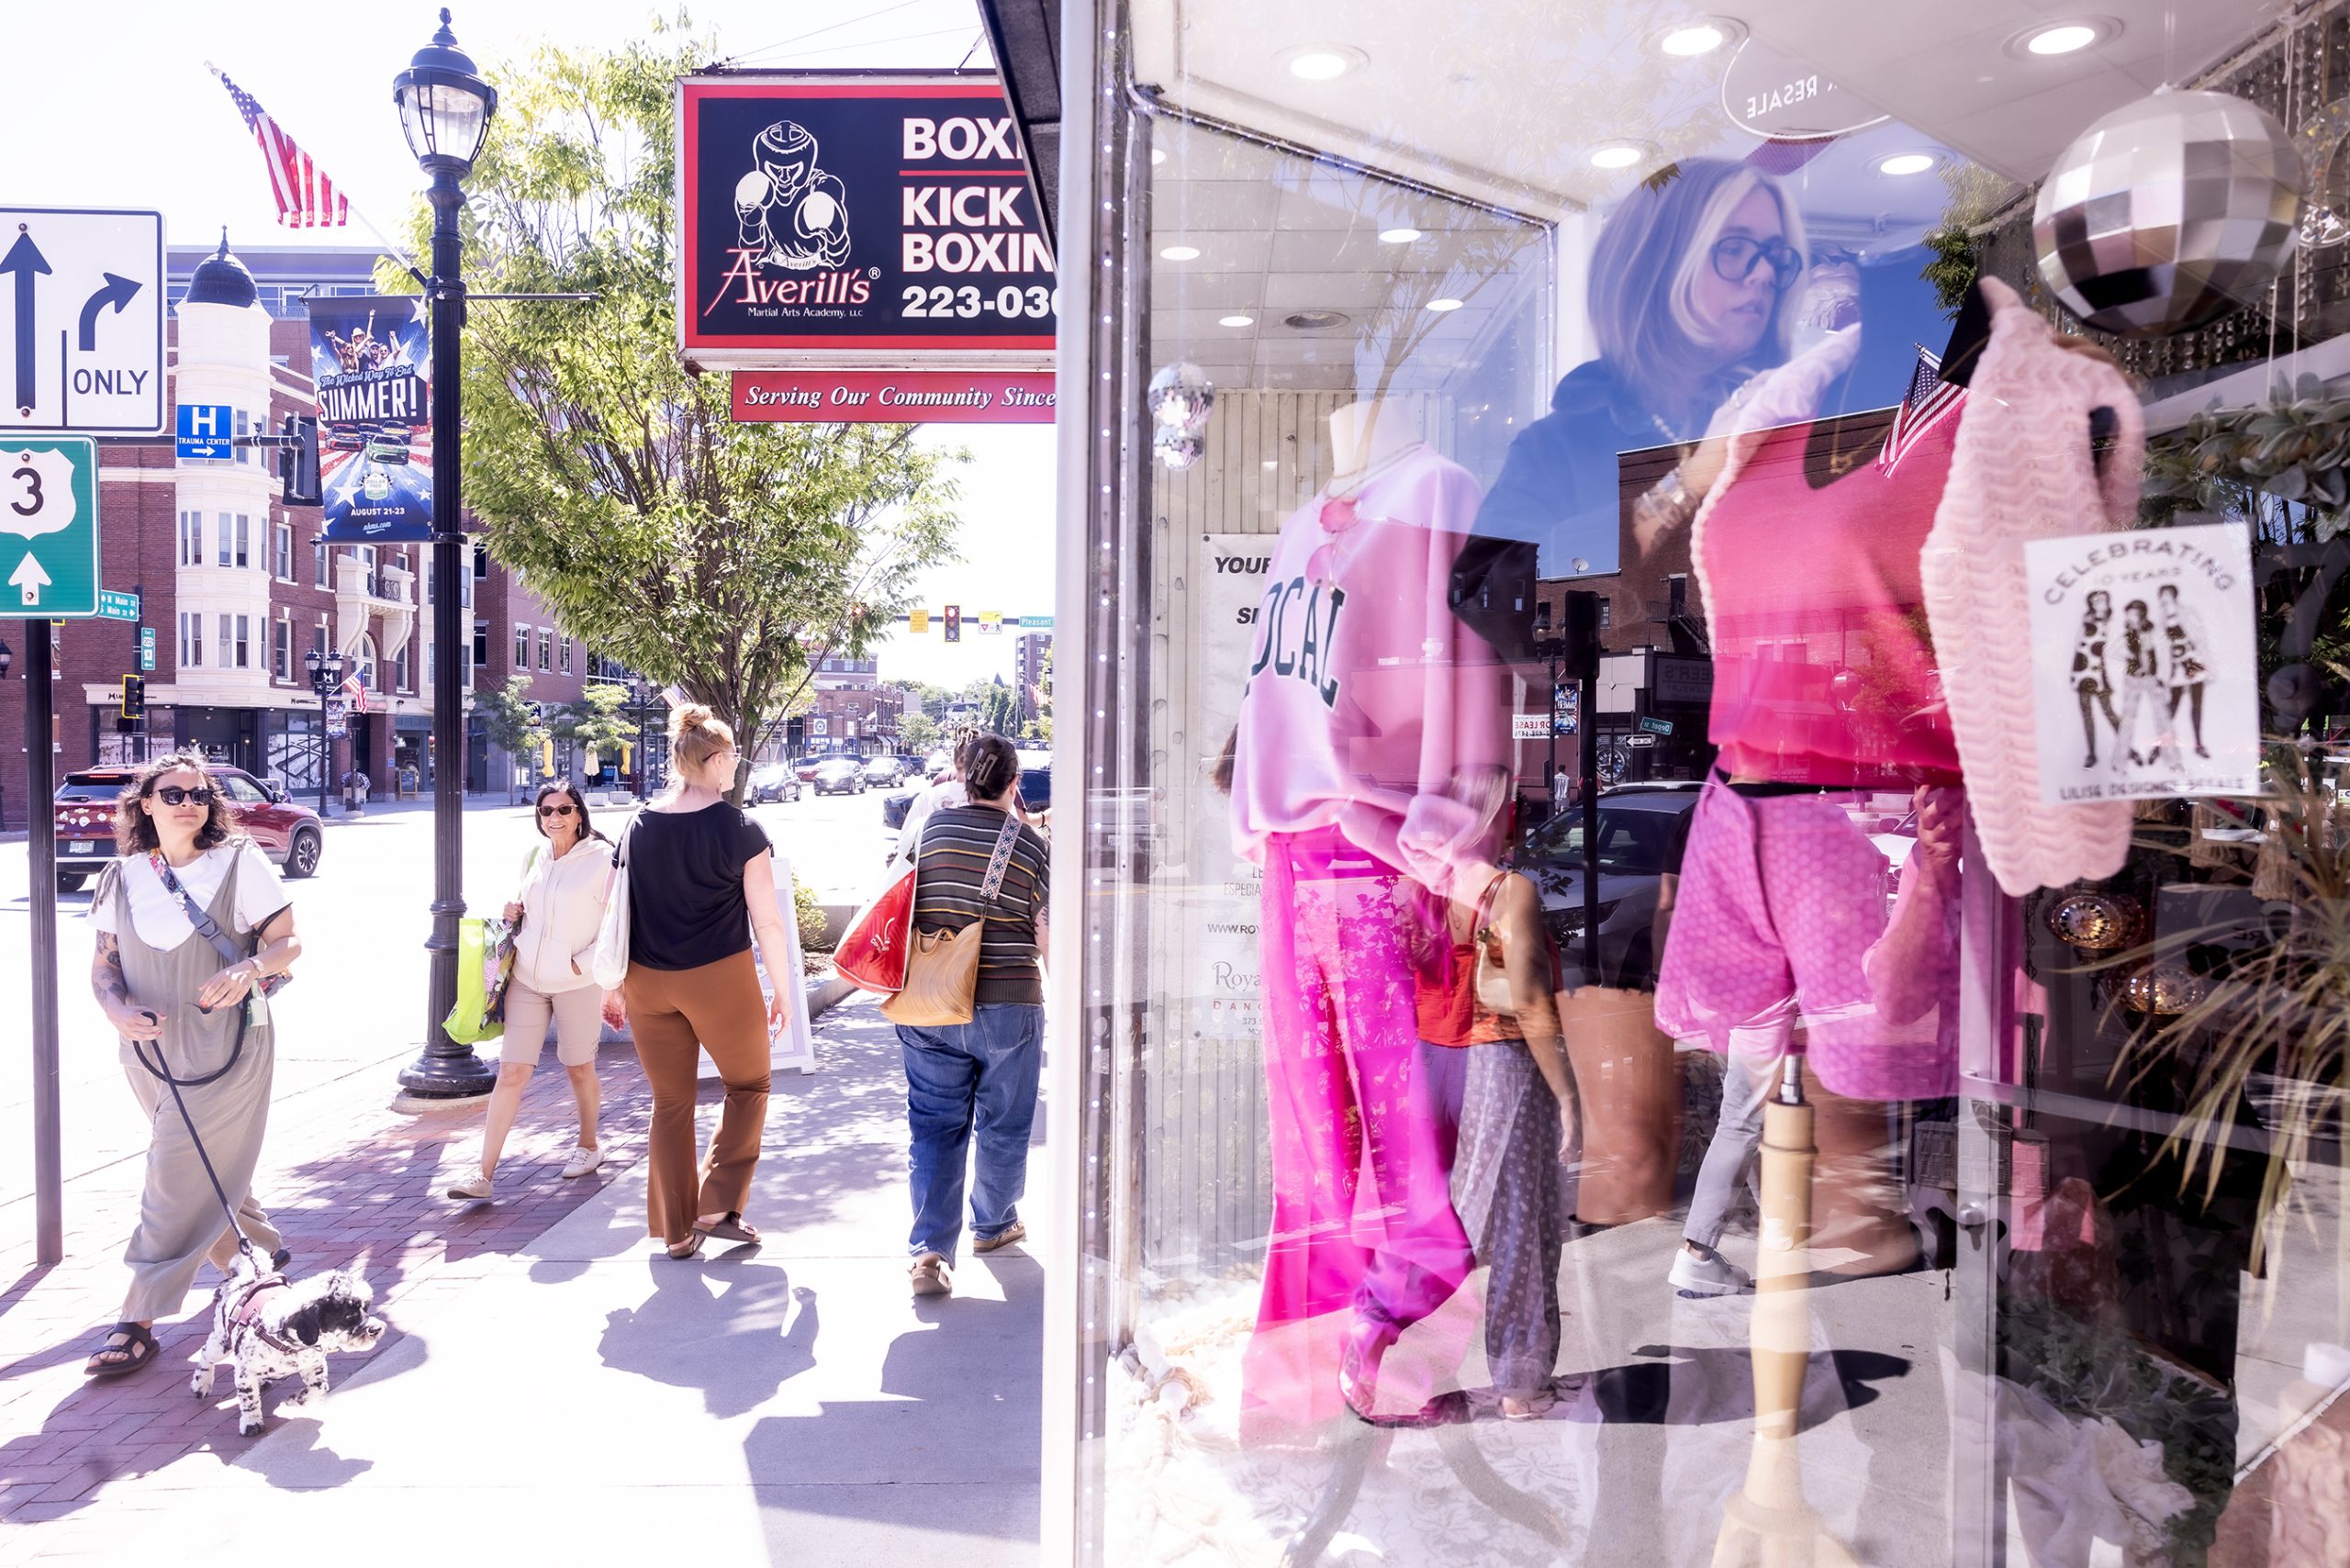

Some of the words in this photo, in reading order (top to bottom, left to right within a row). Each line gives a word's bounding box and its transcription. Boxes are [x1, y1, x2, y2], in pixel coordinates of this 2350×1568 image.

[902, 117, 1024, 161] BOX
[902, 185, 1024, 227] KICK
[747, 307, 778, 318] Martial
[781, 307, 800, 318] Arts
[803, 308, 846, 319] Academy,
[849, 309, 864, 318] LLC
[73, 368, 149, 396] ONLY
[320, 375, 336, 386] The
[336, 371, 364, 386] Wicked
[364, 369, 384, 382] Way
[396, 364, 413, 377] End
[318, 376, 417, 422] SUMMER!
[744, 386, 822, 409] Serving
[829, 386, 870, 406] Our
[878, 386, 993, 410] Community
[1001, 387, 1056, 407] Since
[192, 407, 217, 436] H
[178, 437, 204, 445] TRAUMA
[206, 437, 230, 446] CENTER
[10, 466, 44, 517] 3
[351, 508, 382, 517] AUGUST
[383, 507, 405, 515] 21-23
[2043, 538, 2236, 606] CELEBRATING
[106, 606, 120, 616] Main
[115, 596, 129, 606] Main
[1021, 618, 1052, 626] Pleasant
[1242, 1017, 1257, 1025] 373
